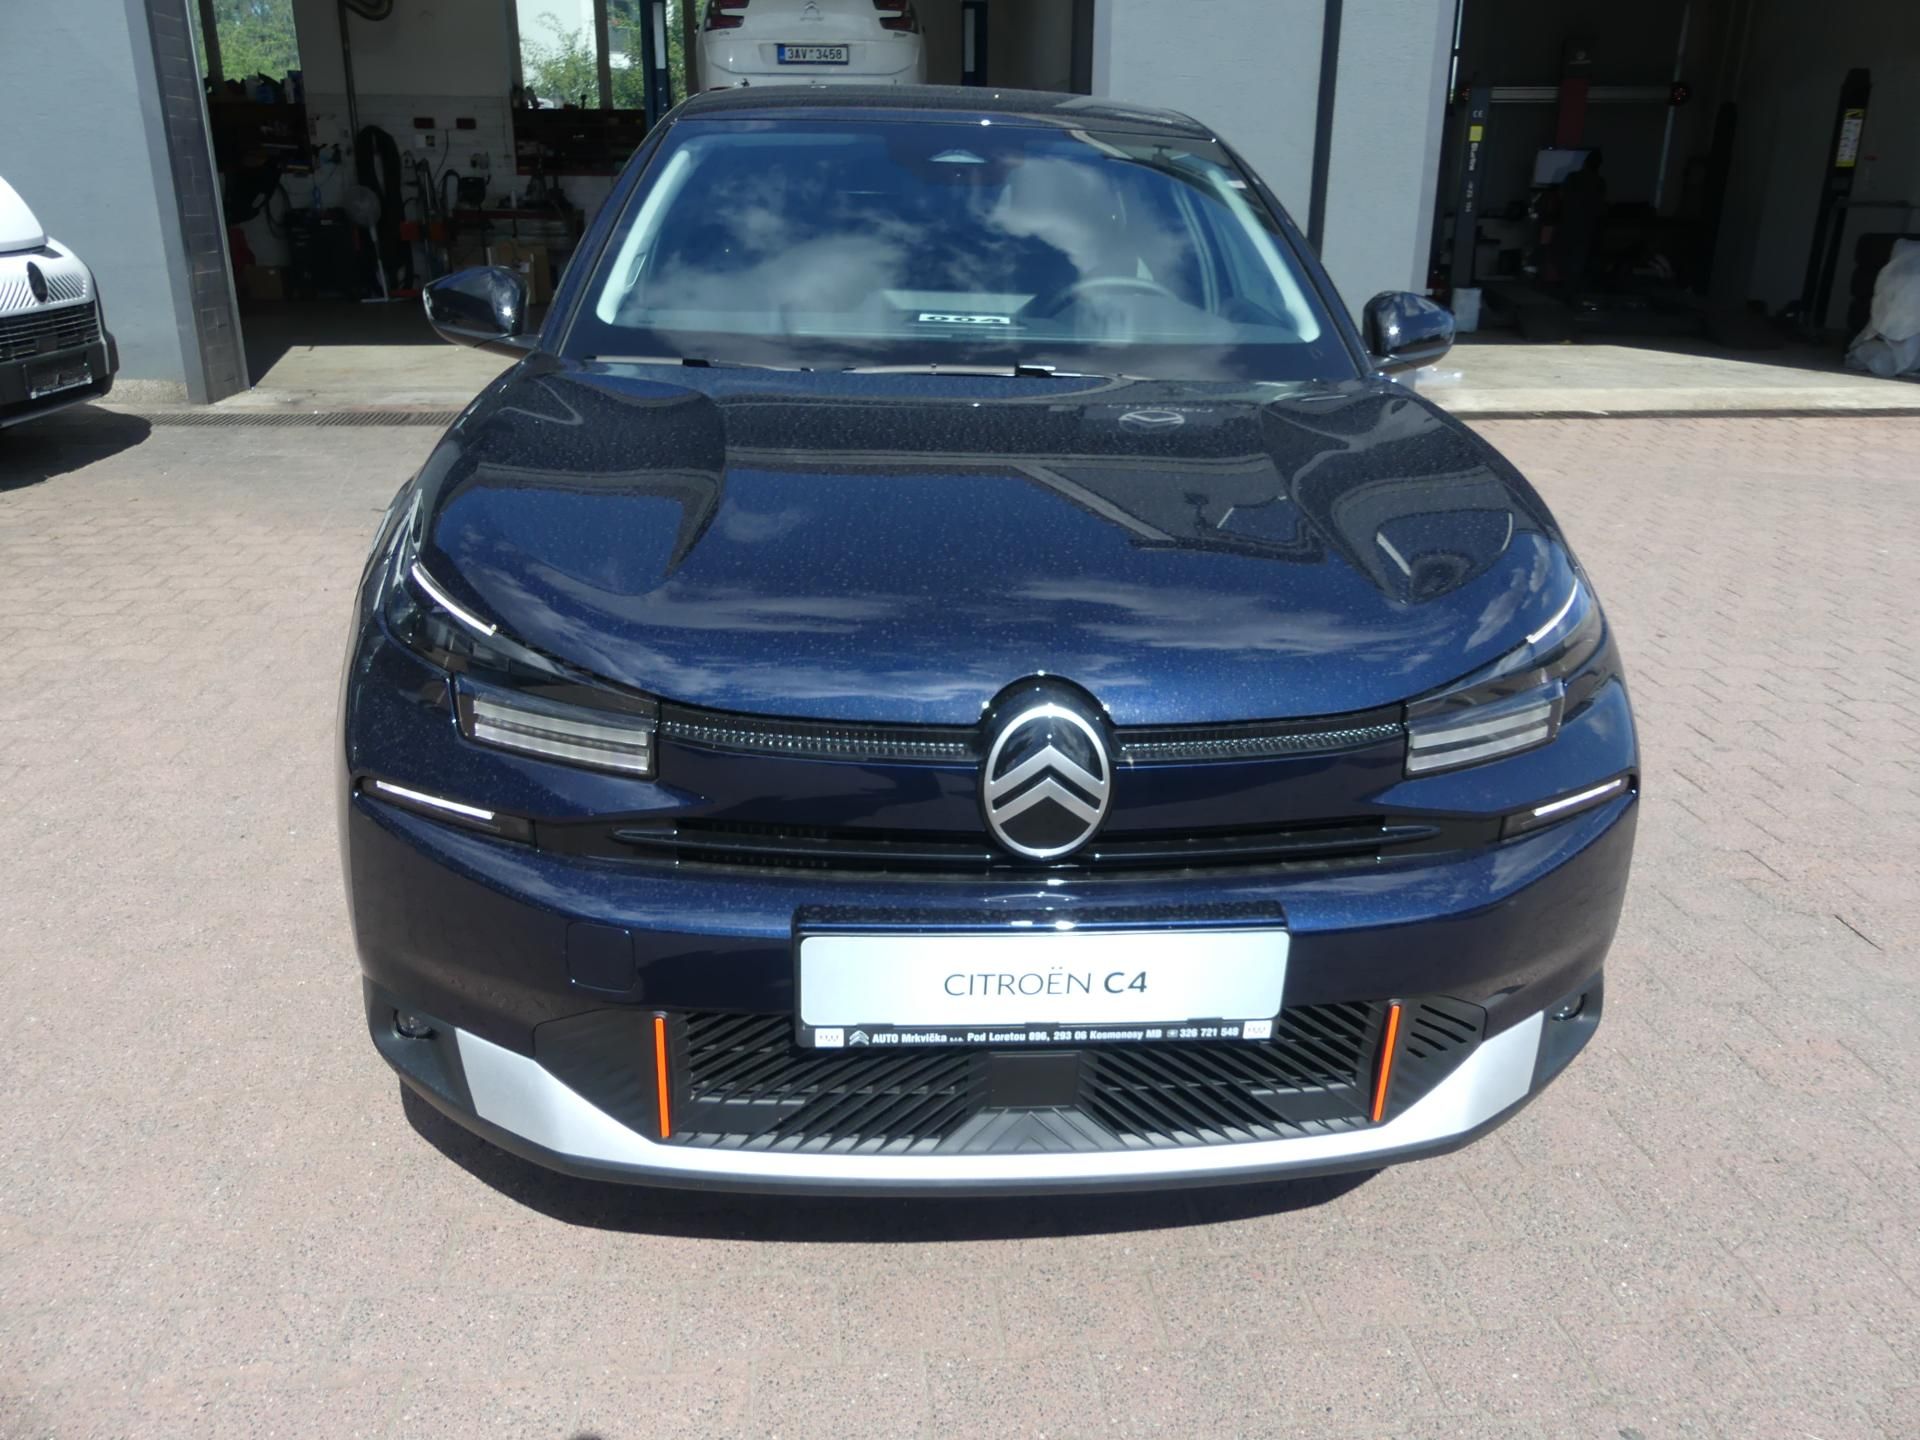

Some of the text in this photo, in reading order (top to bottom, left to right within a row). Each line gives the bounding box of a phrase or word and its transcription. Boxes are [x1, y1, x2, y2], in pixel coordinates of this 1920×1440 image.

[787, 48, 843, 60] 3AV 3458
[944, 966, 1148, 996] CITROËN C4
[872, 1033, 898, 1043] AUTO
[901, 1032, 947, 1043] Mrkvička
[967, 1032, 986, 1042] Pod
[989, 1031, 1026, 1042] Loretou
[1053, 1030, 1072, 1041] 293
[1089, 1030, 1143, 1041] Kosmonosy
[1179, 1028, 1197, 1038] 326
[1200, 1027, 1217, 1037] 721
